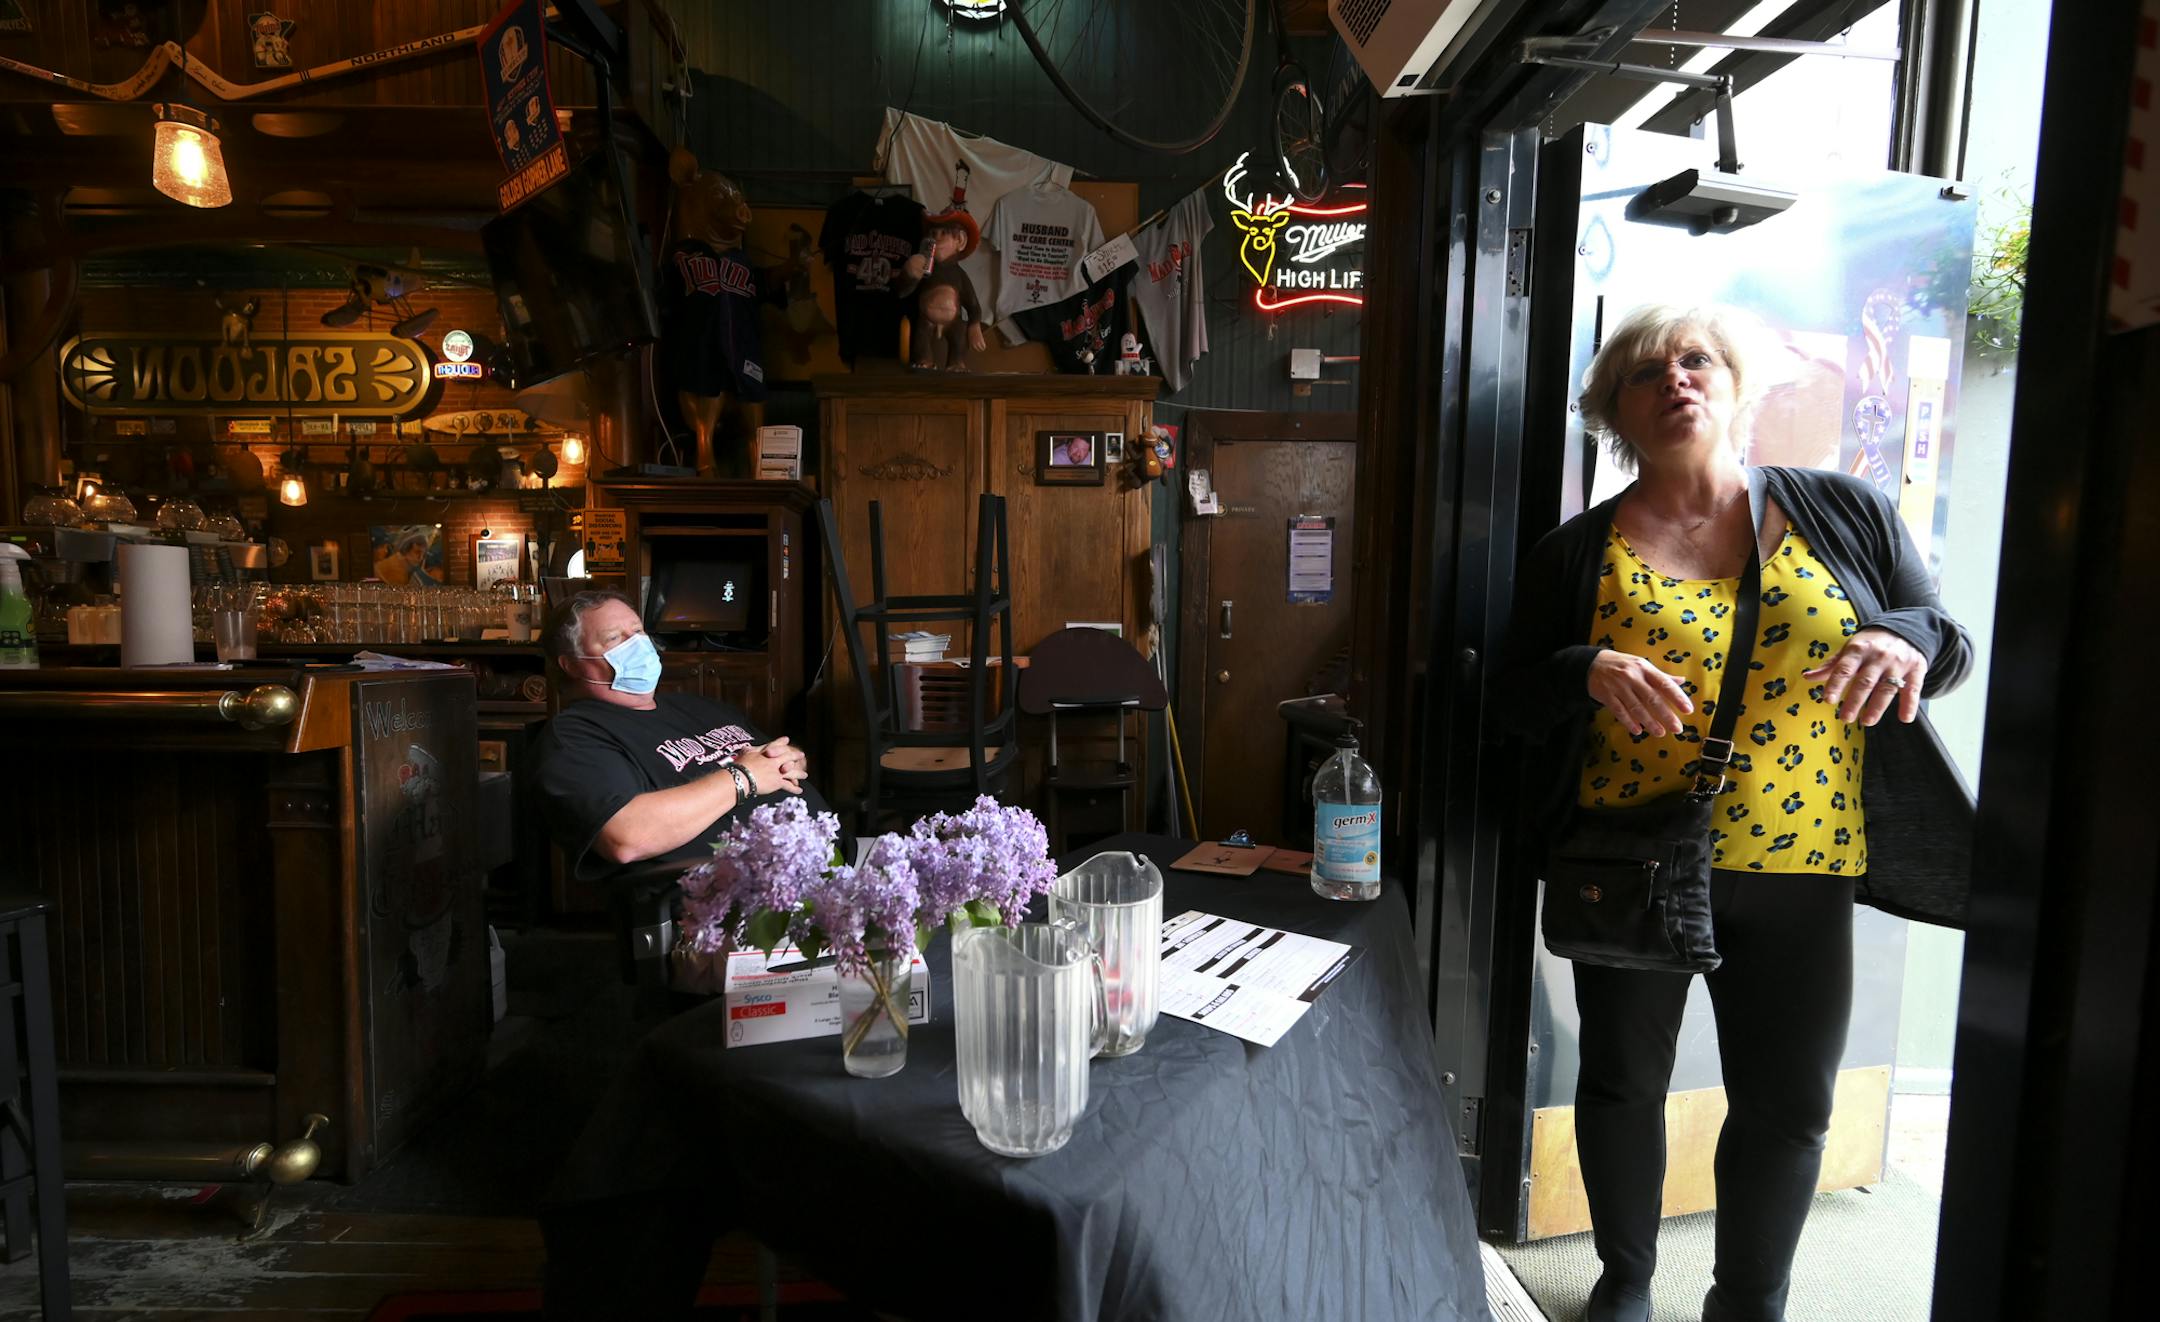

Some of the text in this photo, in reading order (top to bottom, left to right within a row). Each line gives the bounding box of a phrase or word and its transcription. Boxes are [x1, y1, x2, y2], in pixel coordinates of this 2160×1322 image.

[351, 32, 456, 66] NORTHLAND
[499, 146, 567, 210] GOLDEN GOPHER LANE
[1013, 233, 1074, 248] DAY CARE CENTER
[1021, 223, 1069, 237] HUSBAND
[1285, 221, 1367, 263] Miller
[672, 250, 757, 298] Twin
[1276, 268, 1363, 289] HIGH LIF
[1914, 402, 1933, 459] PSH
[366, 697, 432, 741] Welco
[656, 737, 705, 773] MAD
[739, 1003, 777, 1017] Classic
[743, 993, 773, 1004] Sysco
